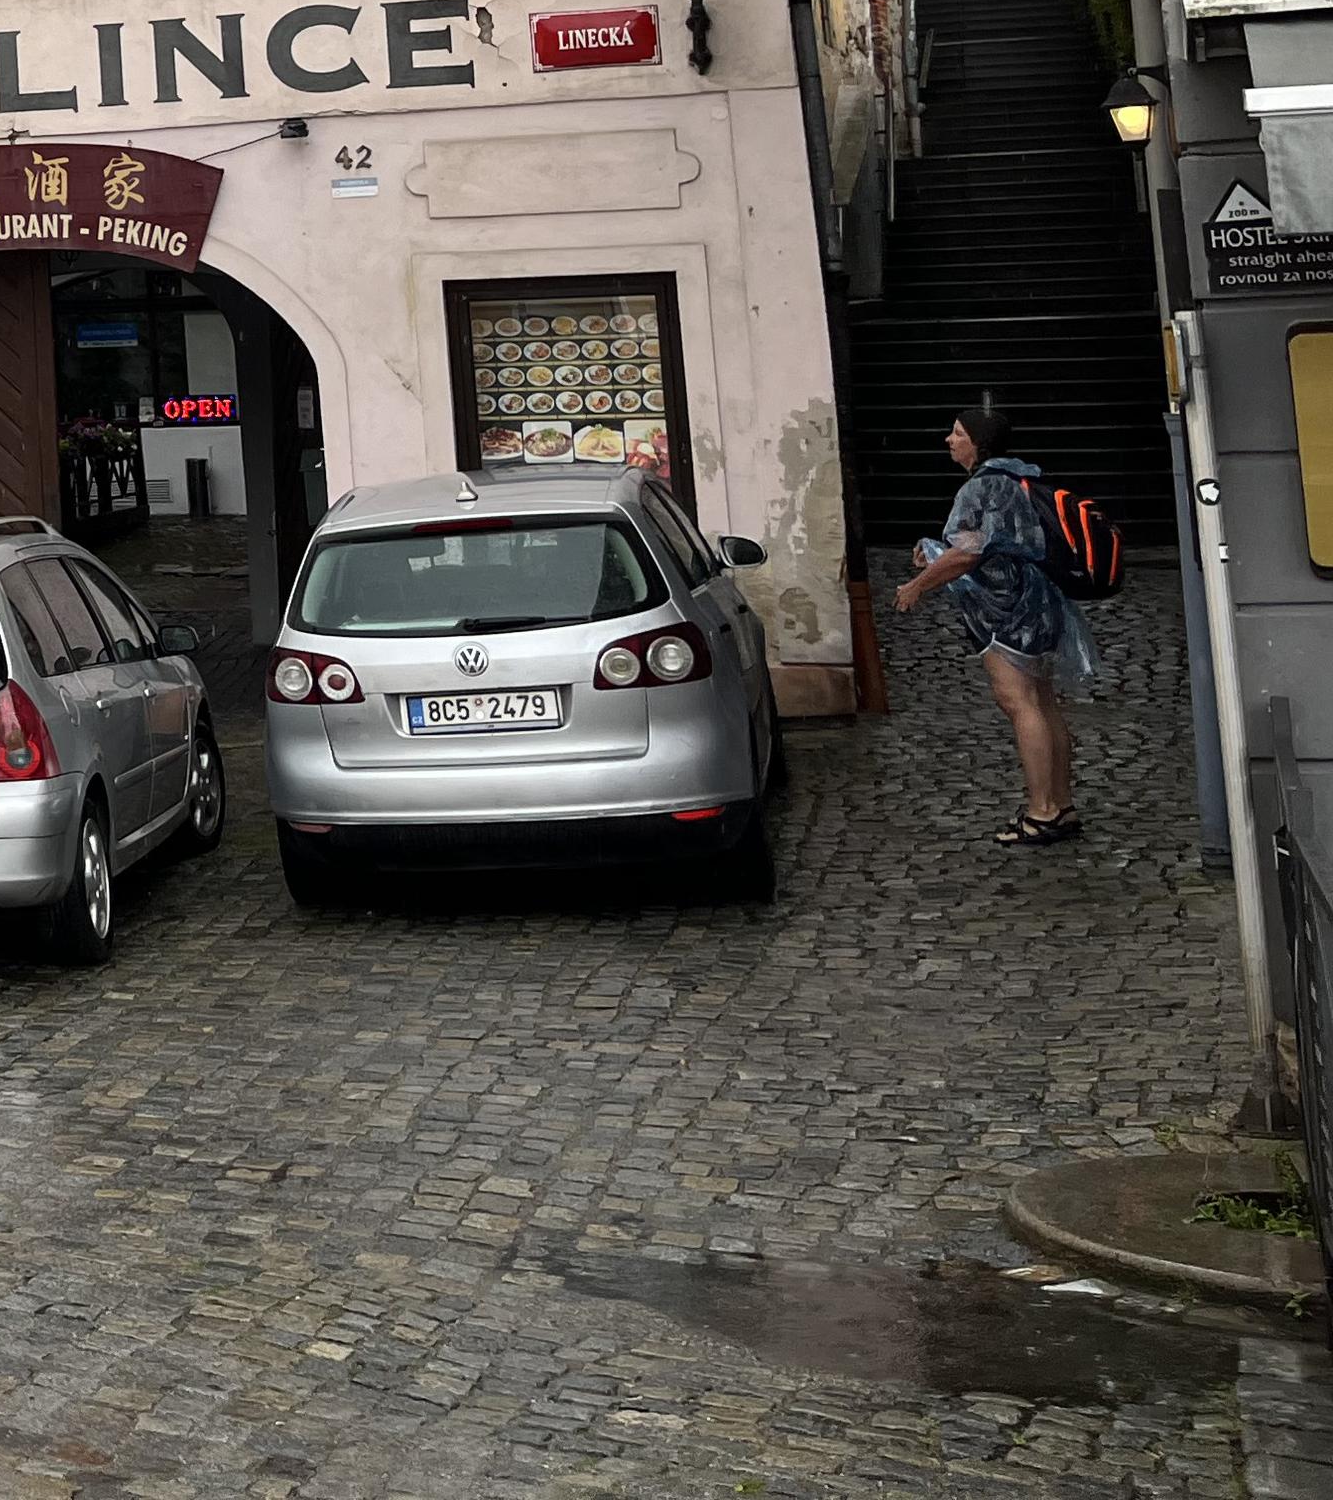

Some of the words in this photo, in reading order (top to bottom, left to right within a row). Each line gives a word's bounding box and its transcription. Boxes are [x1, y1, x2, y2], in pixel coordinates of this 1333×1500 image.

[557, 20, 634, 51] LINECKÁ
[335, 144, 373, 170] 42
[97, 215, 188, 256] PEKING
[1229, 252, 1292, 268] straight
[1219, 273, 1278, 286] rovnou
[1283, 271, 1301, 282] za
[164, 399, 232, 419] OPEN
[412, 716, 423, 725] CZ
[427, 698, 470, 722] 8C5
[487, 694, 546, 719] 2479
